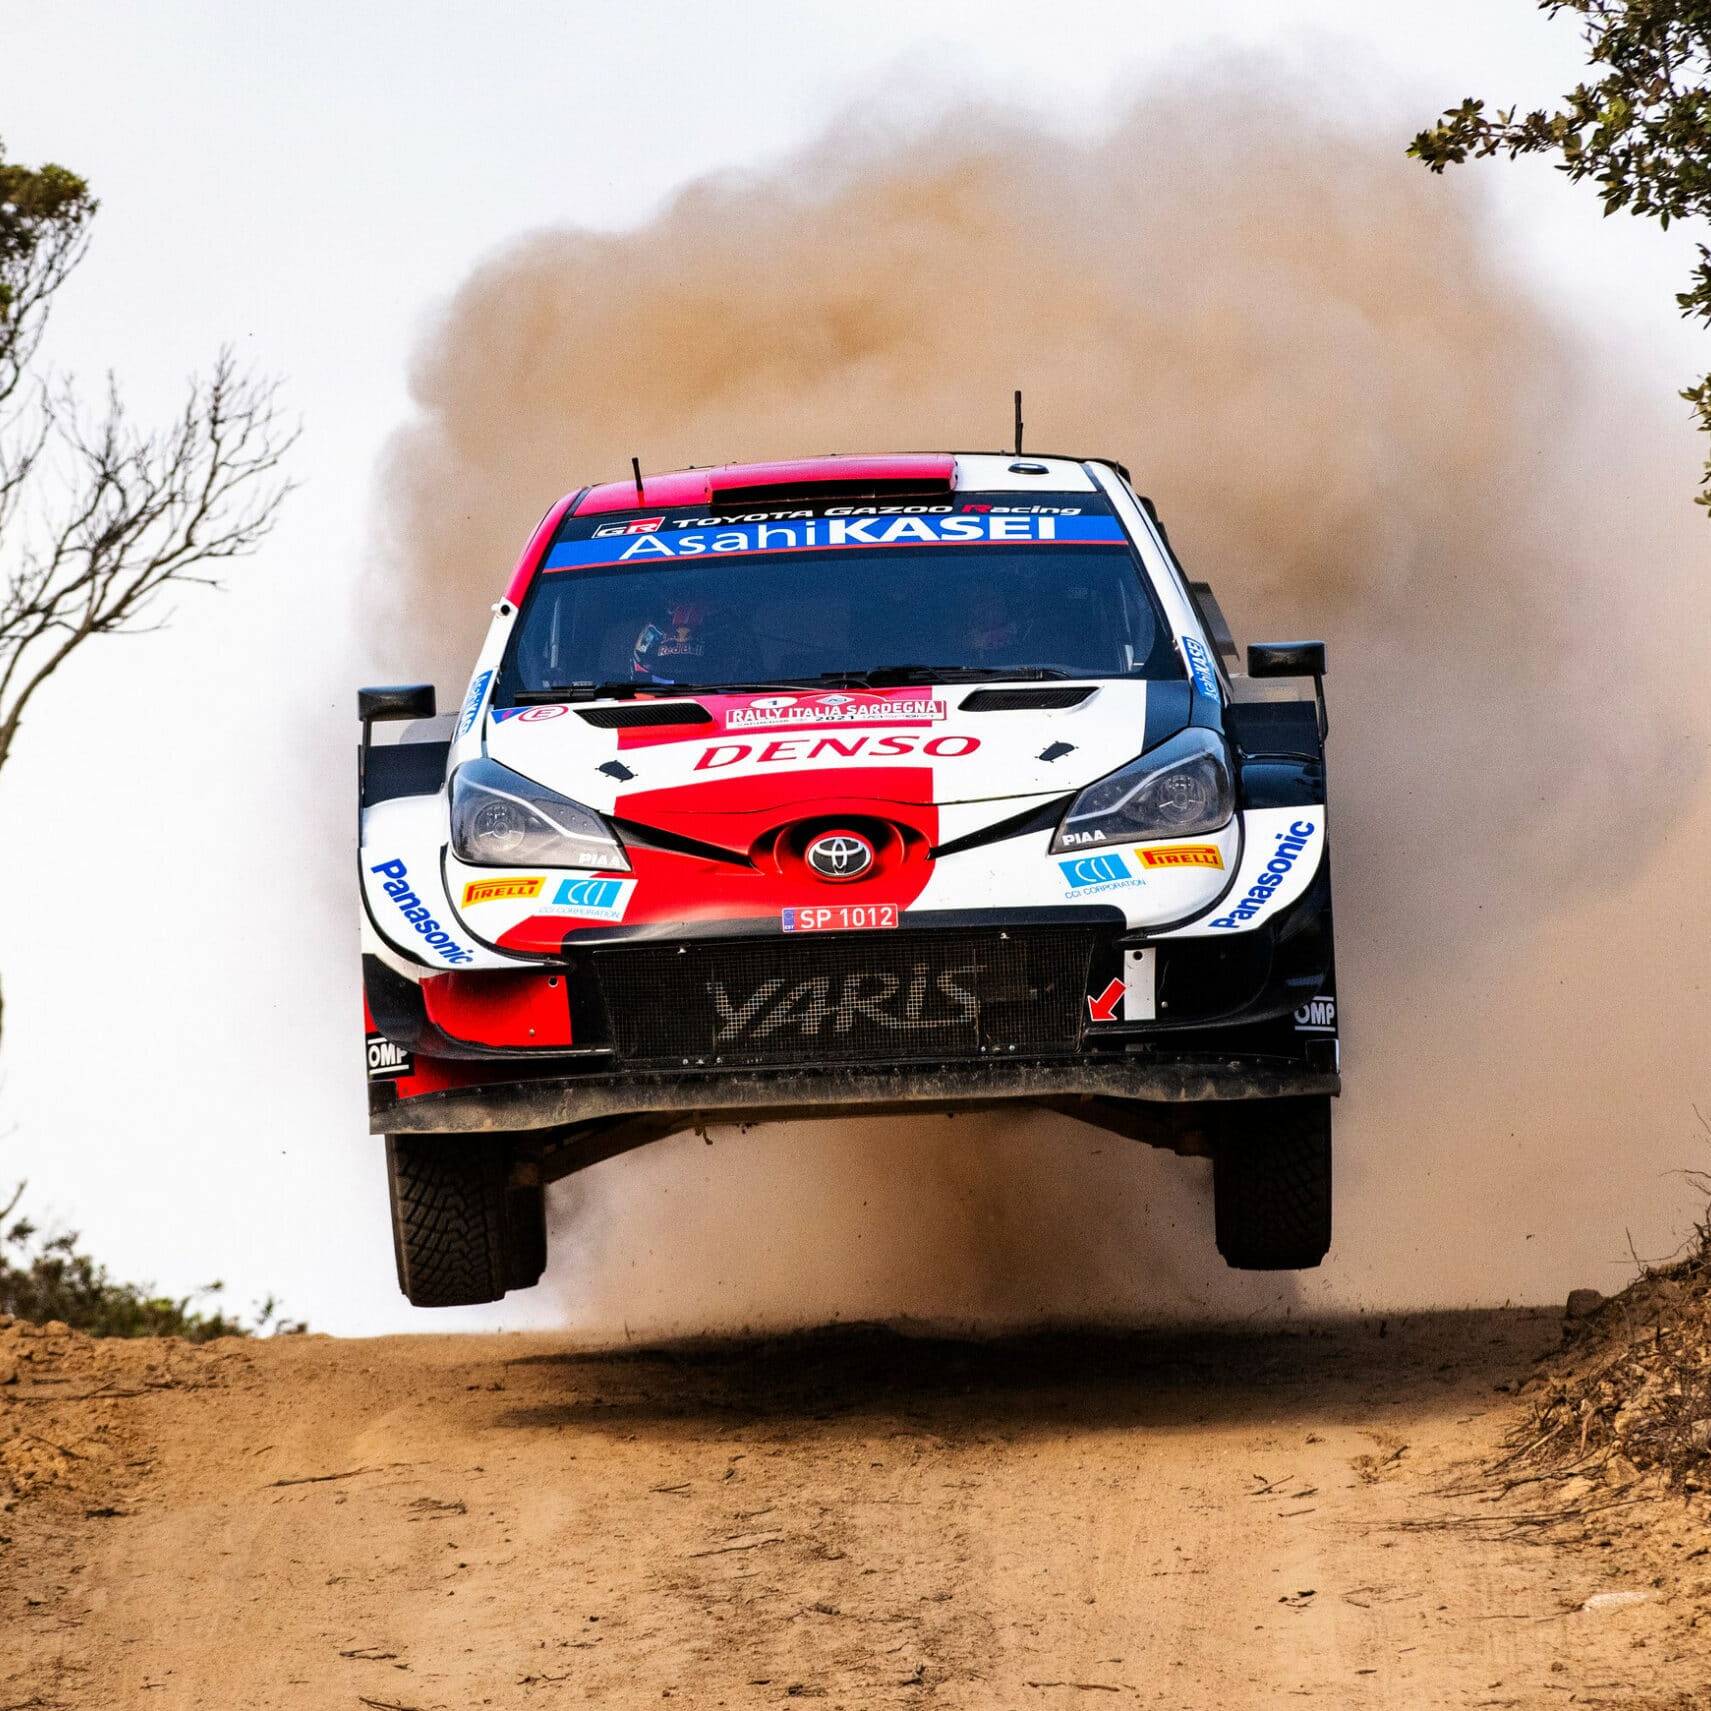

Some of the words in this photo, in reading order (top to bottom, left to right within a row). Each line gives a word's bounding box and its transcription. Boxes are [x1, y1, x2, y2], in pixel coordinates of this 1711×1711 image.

[598, 523, 656, 536] GR
[673, 511, 813, 528] TOYOTA
[824, 505, 953, 516] GAZOO
[961, 504, 1082, 516] Racing
[733, 707, 783, 722] RALLY
[789, 705, 841, 718] ITALIA
[846, 701, 937, 715] SARDEGNA
[693, 736, 981, 771] DENSO
[1062, 830, 1107, 845] PIAA
[578, 853, 622, 866] PIAA
[1142, 848, 1219, 864] PIRELLI
[1208, 821, 1315, 928] Panasonic
[466, 880, 539, 902] PIRELLI
[1065, 891, 1082, 899] CCI
[1083, 879, 1147, 896] CORPORATION
[370, 858, 474, 964] Panasonic
[557, 906, 620, 919] CORPORATION
[800, 909, 831, 928] SP
[839, 907, 893, 927] 1012
[1294, 1002, 1334, 1025] OMP
